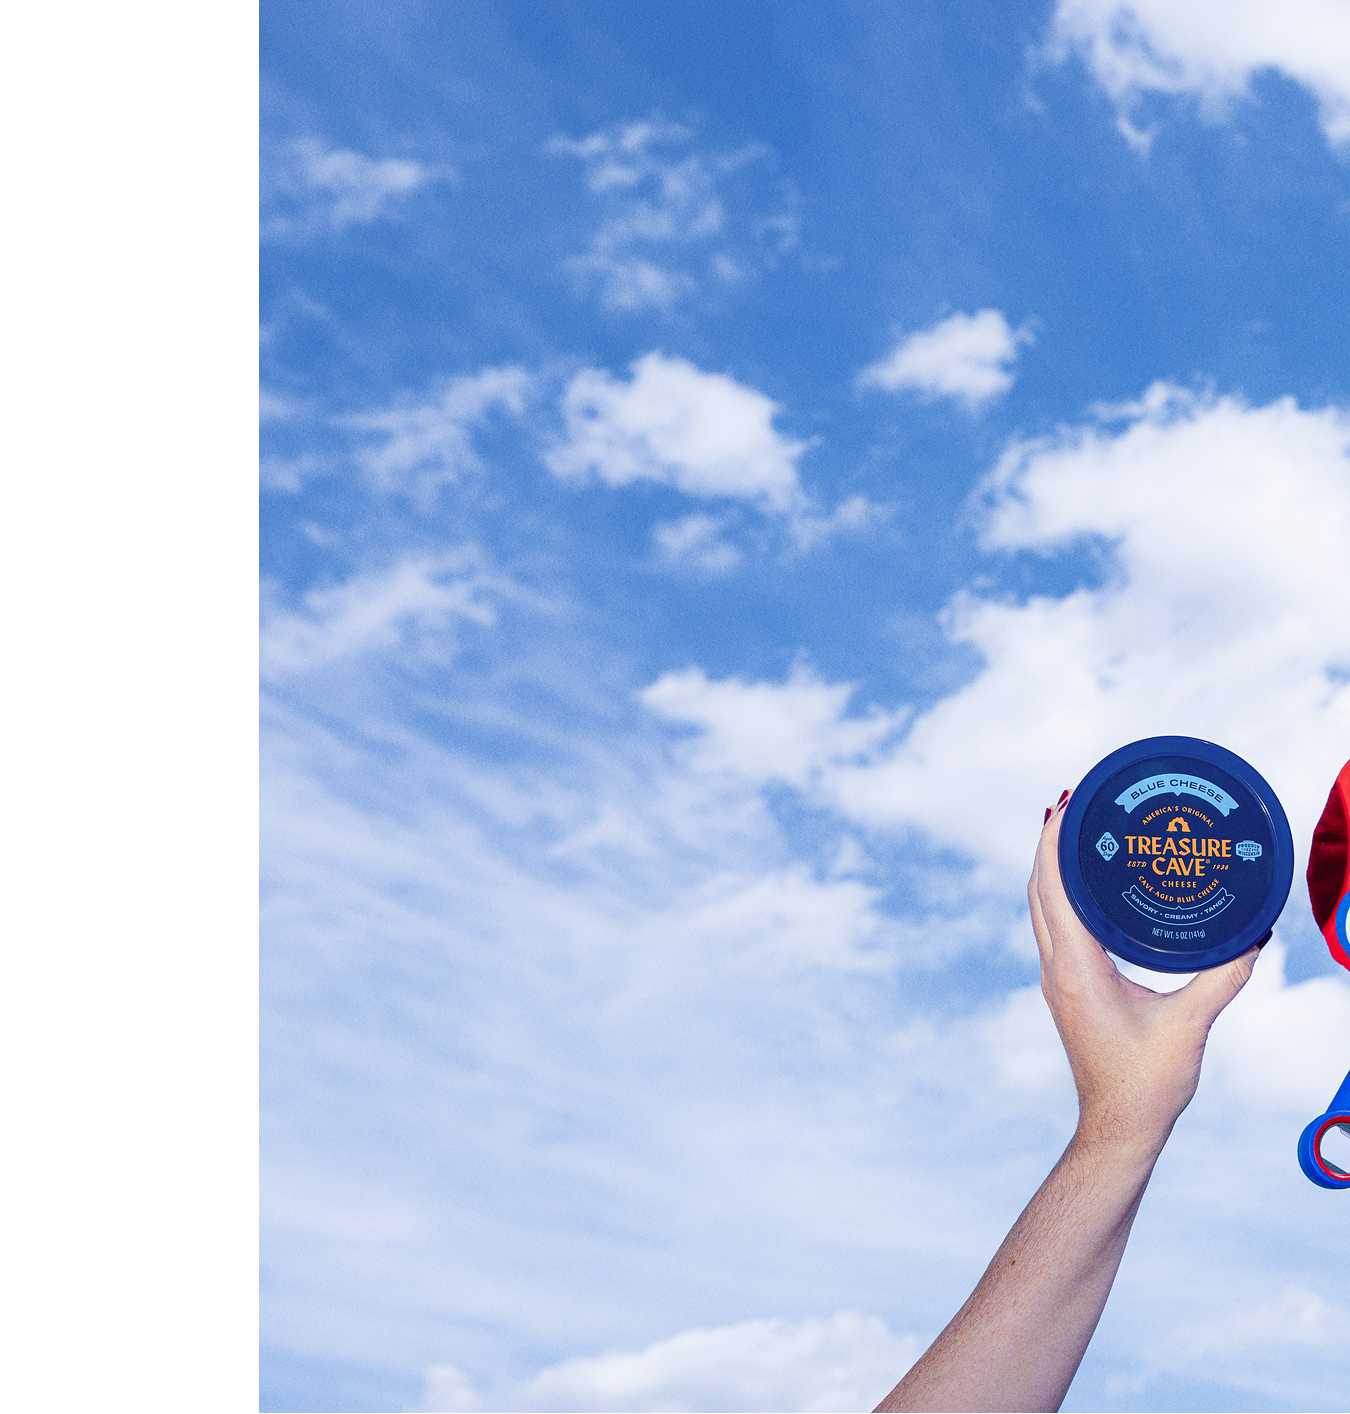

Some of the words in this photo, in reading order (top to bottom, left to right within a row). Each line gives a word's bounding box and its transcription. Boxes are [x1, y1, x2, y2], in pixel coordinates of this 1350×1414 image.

[1130, 780, 1165, 800] BLUE
[1169, 779, 1224, 803] CHEESE
[1142, 805, 1179, 825] AMERICA'S
[1182, 806, 1214, 828] ORIGINAL
[1100, 841, 1115, 852] 60
[1124, 835, 1232, 857] TREASURE
[1138, 875, 1174, 902] CAVE-AGED
[1176, 895, 1195, 903] BLUE
[1197, 878, 1220, 899] CHEESE
[1161, 880, 1197, 888] CHEESE
[1130, 893, 1158, 915] SAVORY
[1164, 912, 1198, 920] CREAMY
[1204, 896, 1226, 914] TANGY
[1151, 927, 1163, 937] NET
[1175, 931, 1179, 939] 5
[1180, 931, 1188, 940] OZ
